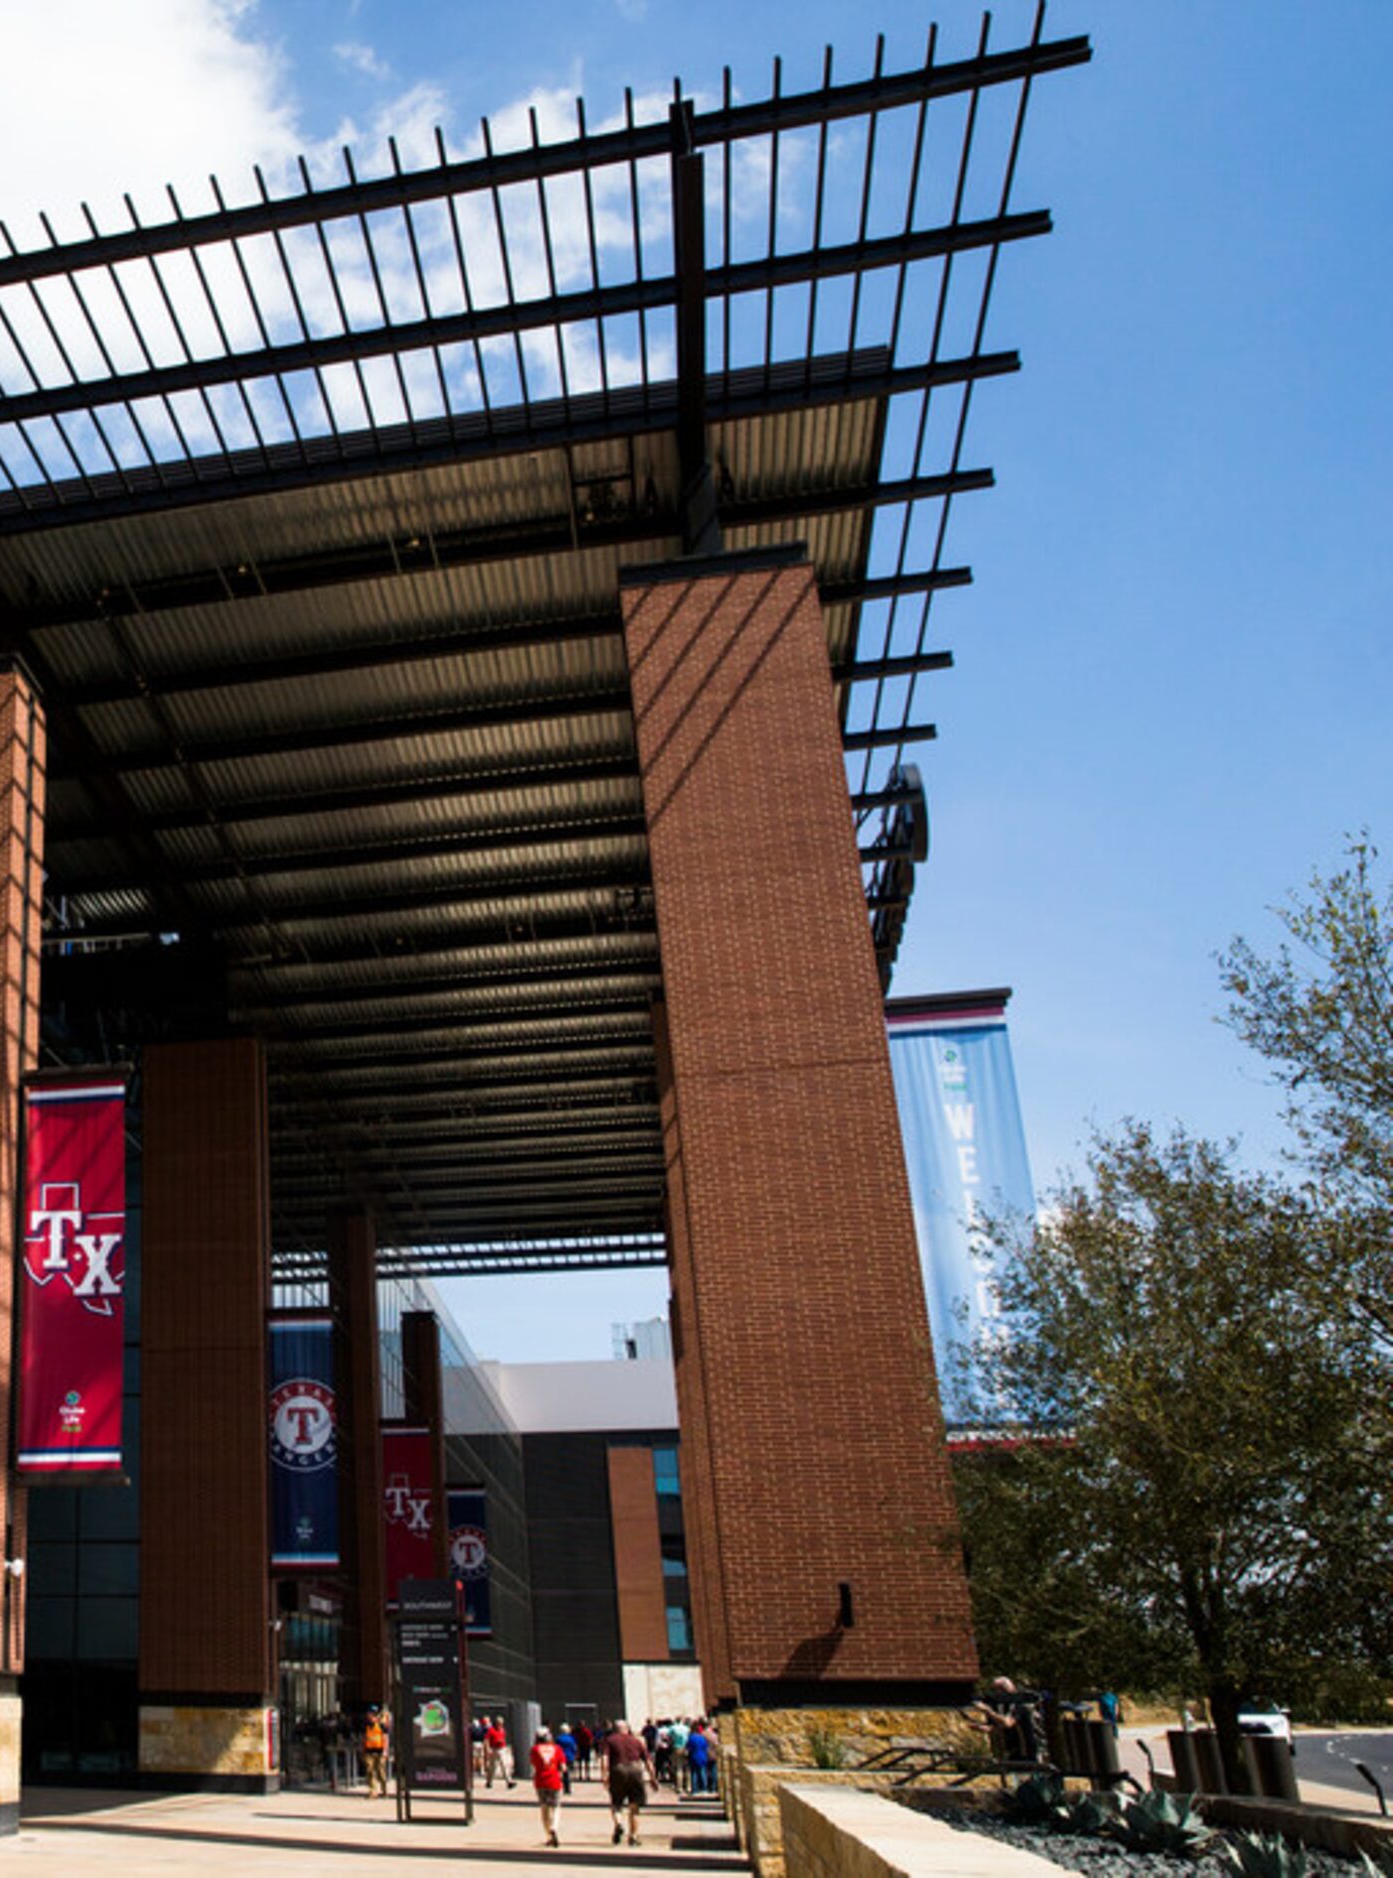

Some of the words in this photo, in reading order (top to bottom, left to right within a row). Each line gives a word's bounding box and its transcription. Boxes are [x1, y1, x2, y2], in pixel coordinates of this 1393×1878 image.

[30, 1210, 123, 1296] TX
[286, 1407, 319, 1446] T
[385, 1487, 431, 1529] TX
[458, 1541, 480, 1564] T
